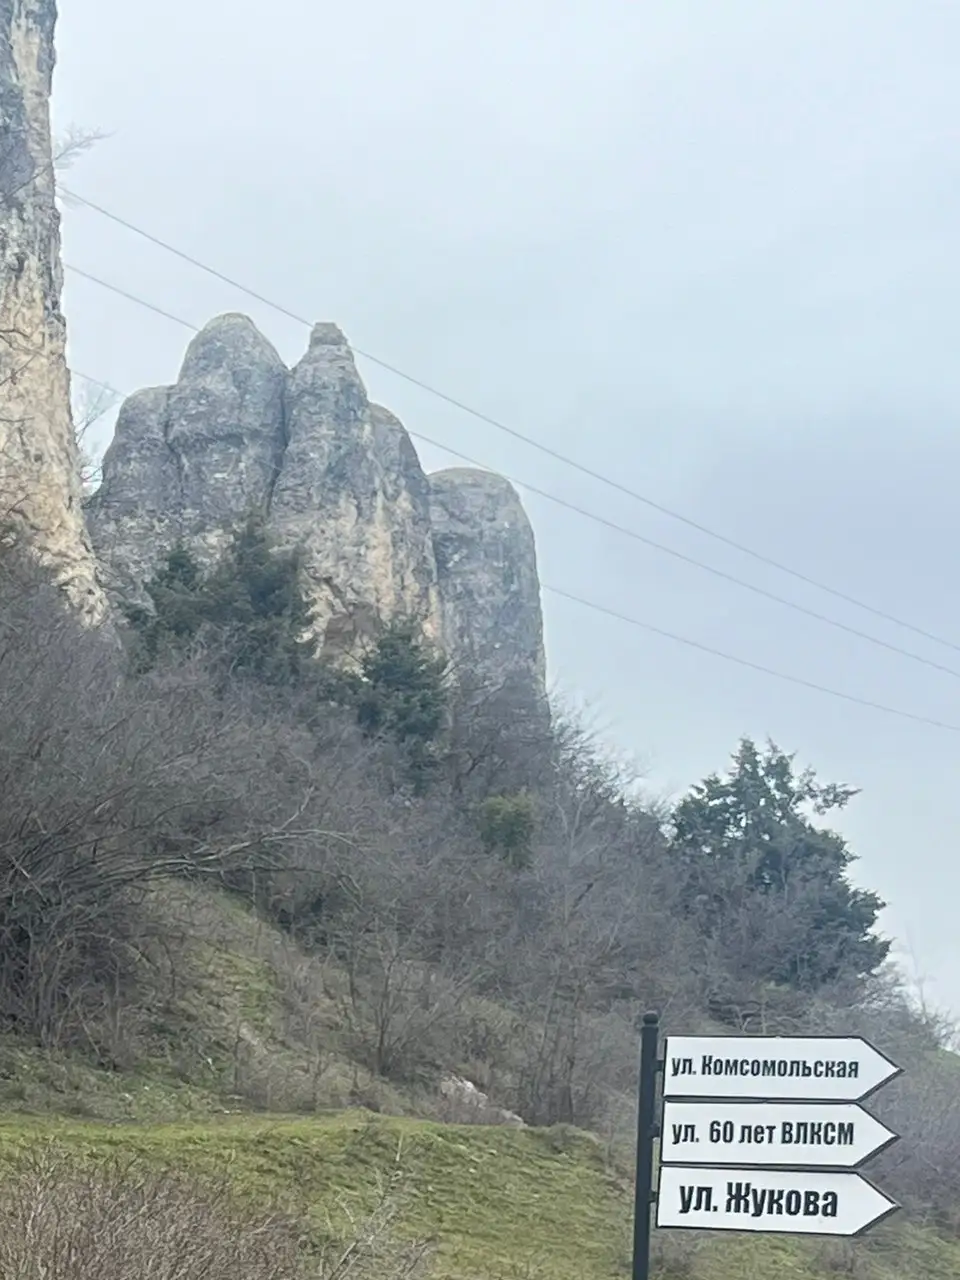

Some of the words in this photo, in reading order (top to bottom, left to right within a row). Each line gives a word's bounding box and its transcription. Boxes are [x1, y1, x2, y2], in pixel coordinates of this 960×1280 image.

[671, 1057, 697, 1077] ул.
[701, 1055, 859, 1078] Комсомольская
[672, 1123, 700, 1145] ул.
[709, 1120, 734, 1143] 60
[738, 1125, 776, 1144] лет
[781, 1121, 855, 1145] ВЛКСМ
[679, 1185, 718, 1213] ул.
[725, 1181, 838, 1217] Жукова
